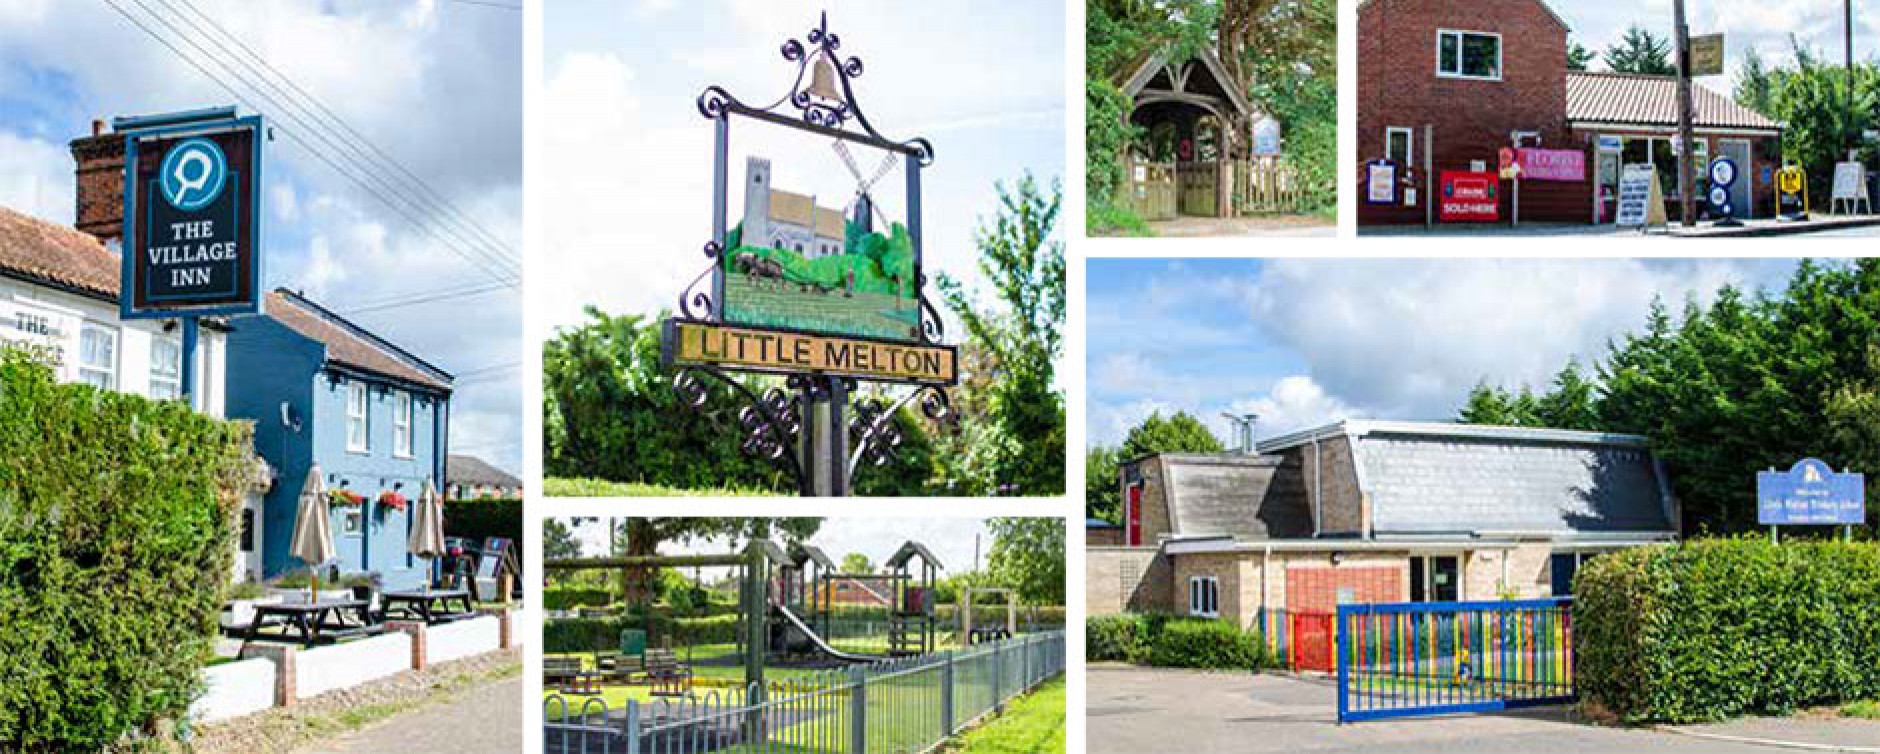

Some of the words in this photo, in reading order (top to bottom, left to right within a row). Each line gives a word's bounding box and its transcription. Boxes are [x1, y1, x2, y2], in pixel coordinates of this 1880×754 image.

[171, 220, 213, 241] THE
[148, 242, 237, 265] VILLAGE
[171, 267, 212, 287] INN
[15, 311, 49, 336] THE
[701, 328, 810, 364] LITTLE
[825, 341, 941, 376] MELTON
